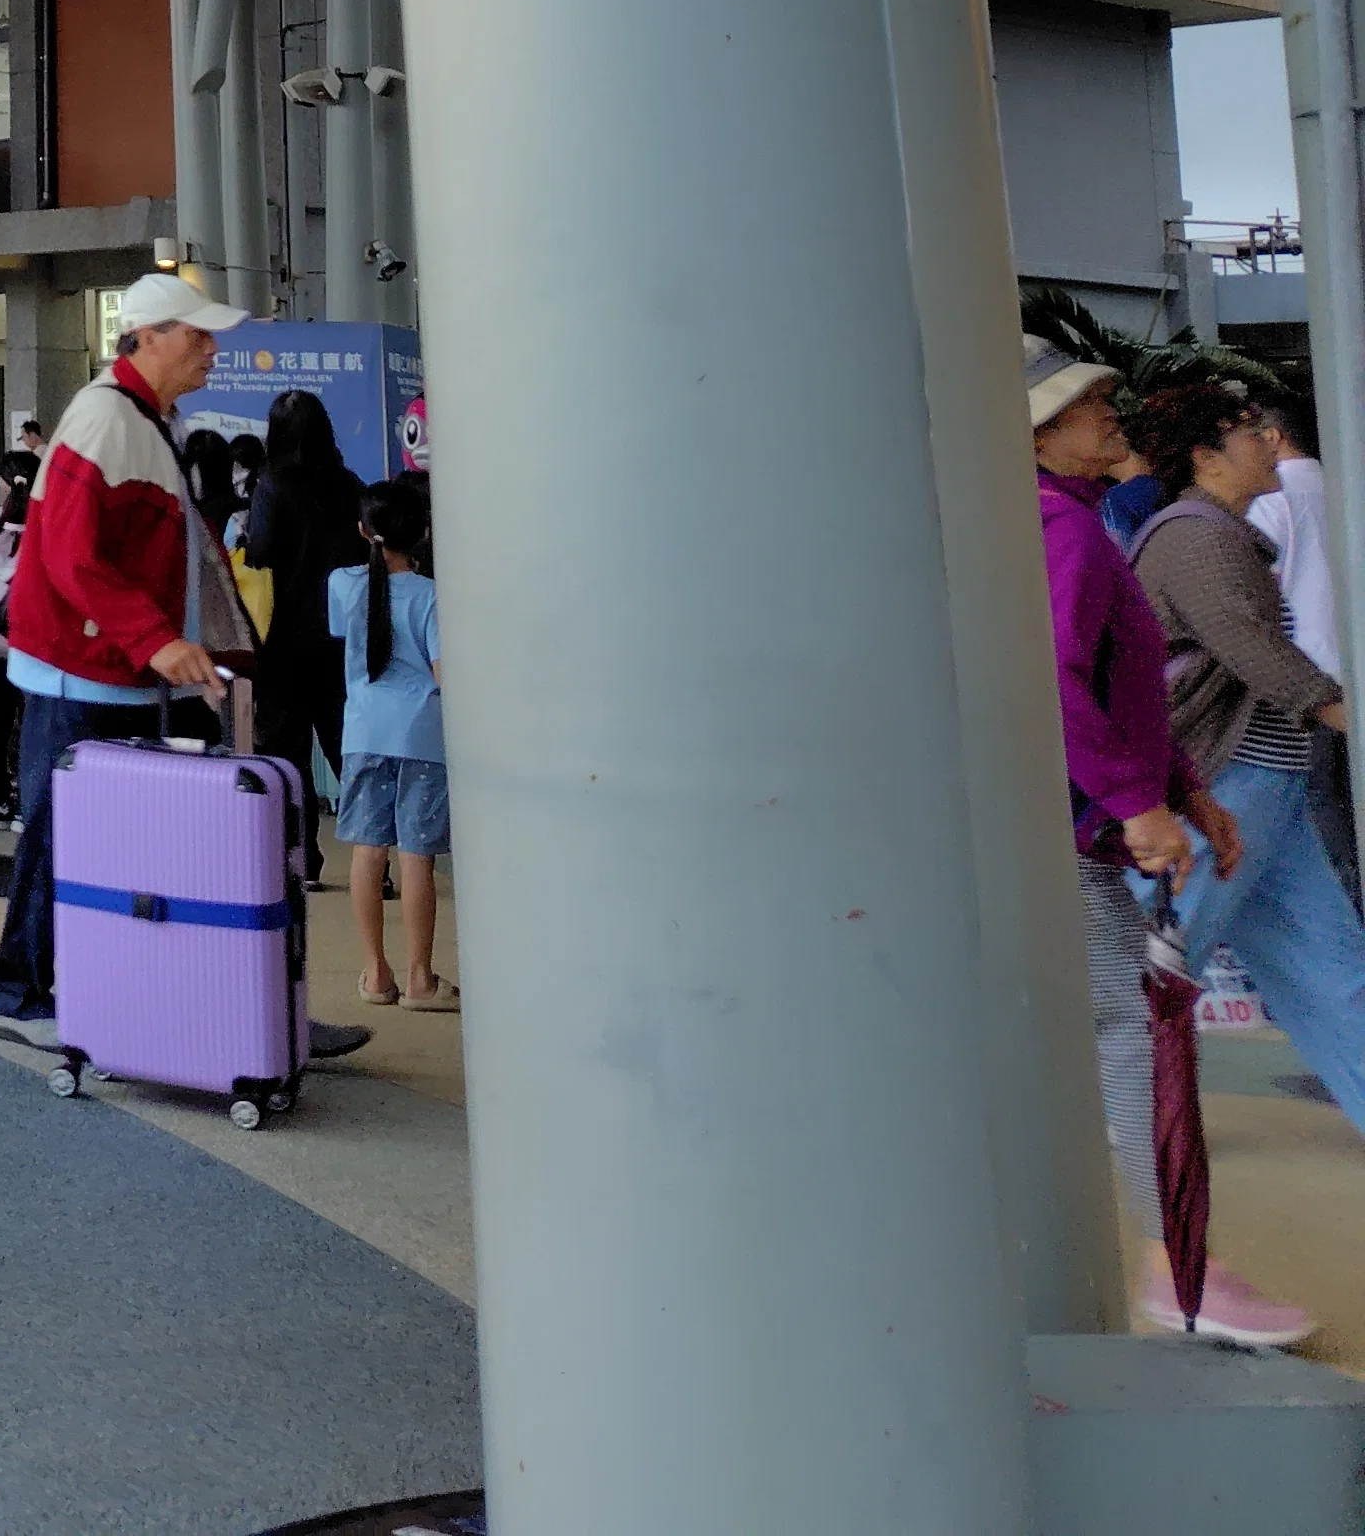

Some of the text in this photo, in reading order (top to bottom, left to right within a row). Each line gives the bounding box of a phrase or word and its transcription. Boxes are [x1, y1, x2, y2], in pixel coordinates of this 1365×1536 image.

[278, 351, 365, 371] 花蓮直航
[223, 372, 247, 382] Flight
[206, 382, 231, 393] Every
[233, 382, 272, 393] Thursday
[272, 383, 290, 391] and
